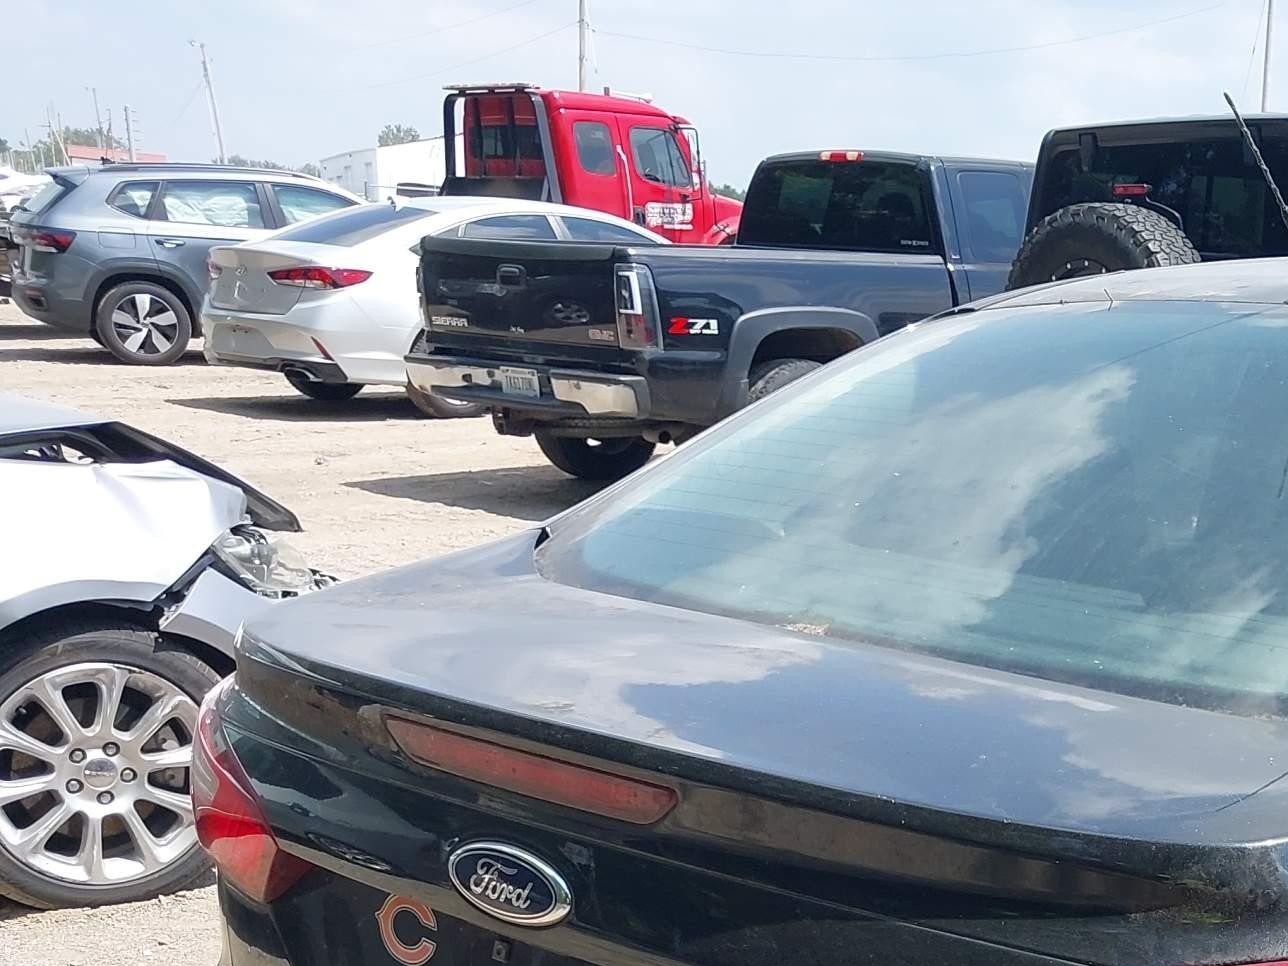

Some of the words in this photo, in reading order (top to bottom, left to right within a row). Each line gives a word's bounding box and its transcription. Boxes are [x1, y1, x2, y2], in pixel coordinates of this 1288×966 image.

[431, 316, 469, 327] SIERRA
[668, 317, 718, 334] Z71
[469, 857, 534, 909] Ford
[374, 893, 438, 966] C
